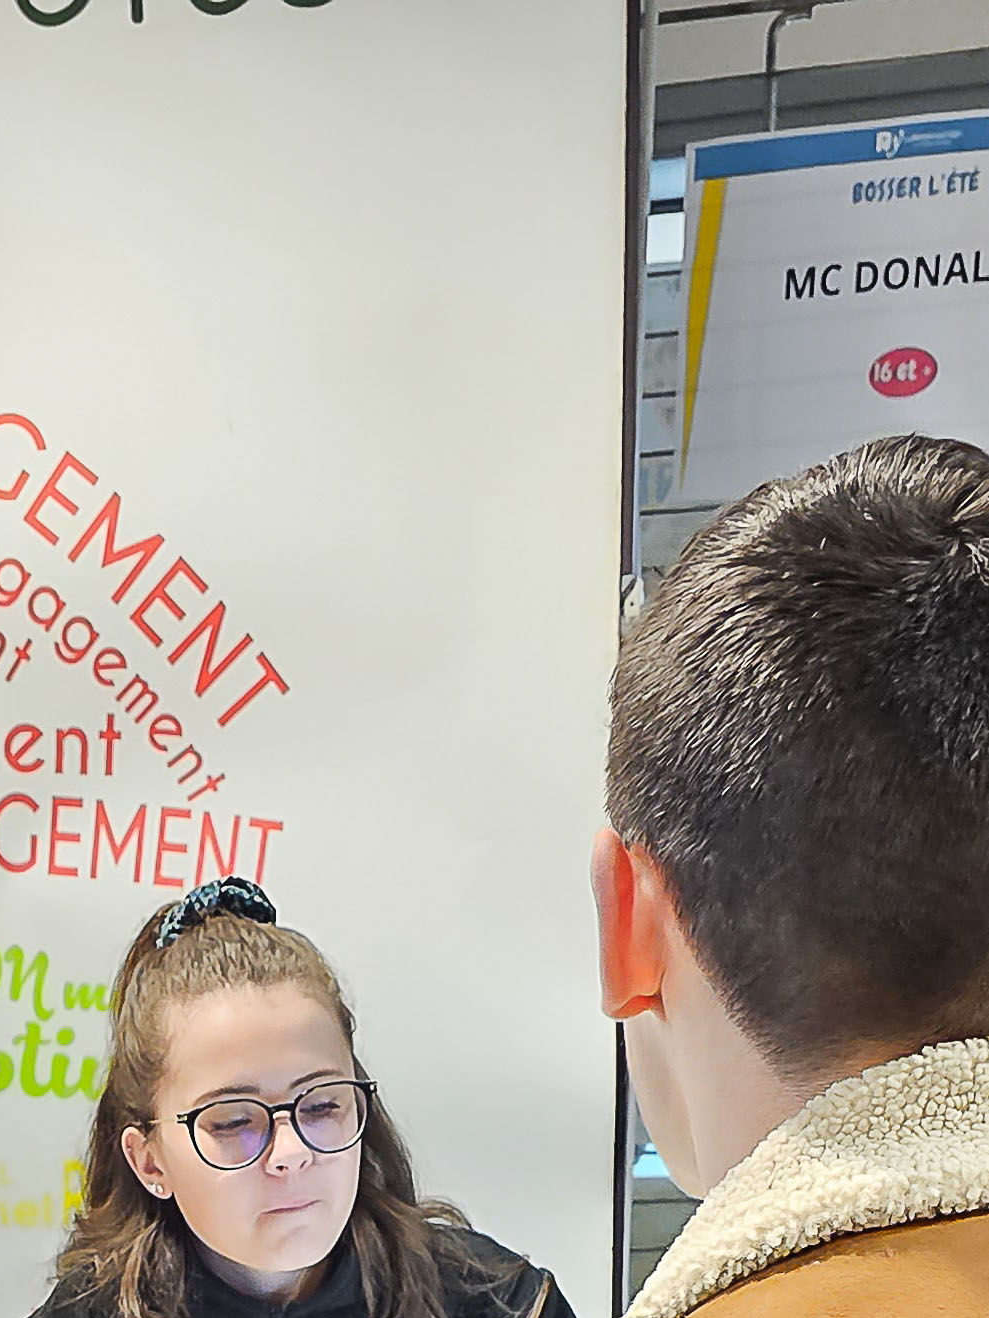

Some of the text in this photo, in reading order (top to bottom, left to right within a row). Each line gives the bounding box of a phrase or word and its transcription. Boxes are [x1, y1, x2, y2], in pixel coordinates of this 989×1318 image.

[852, 176, 922, 206] BOSSER
[784, 249, 989, 301] MC DONAL
